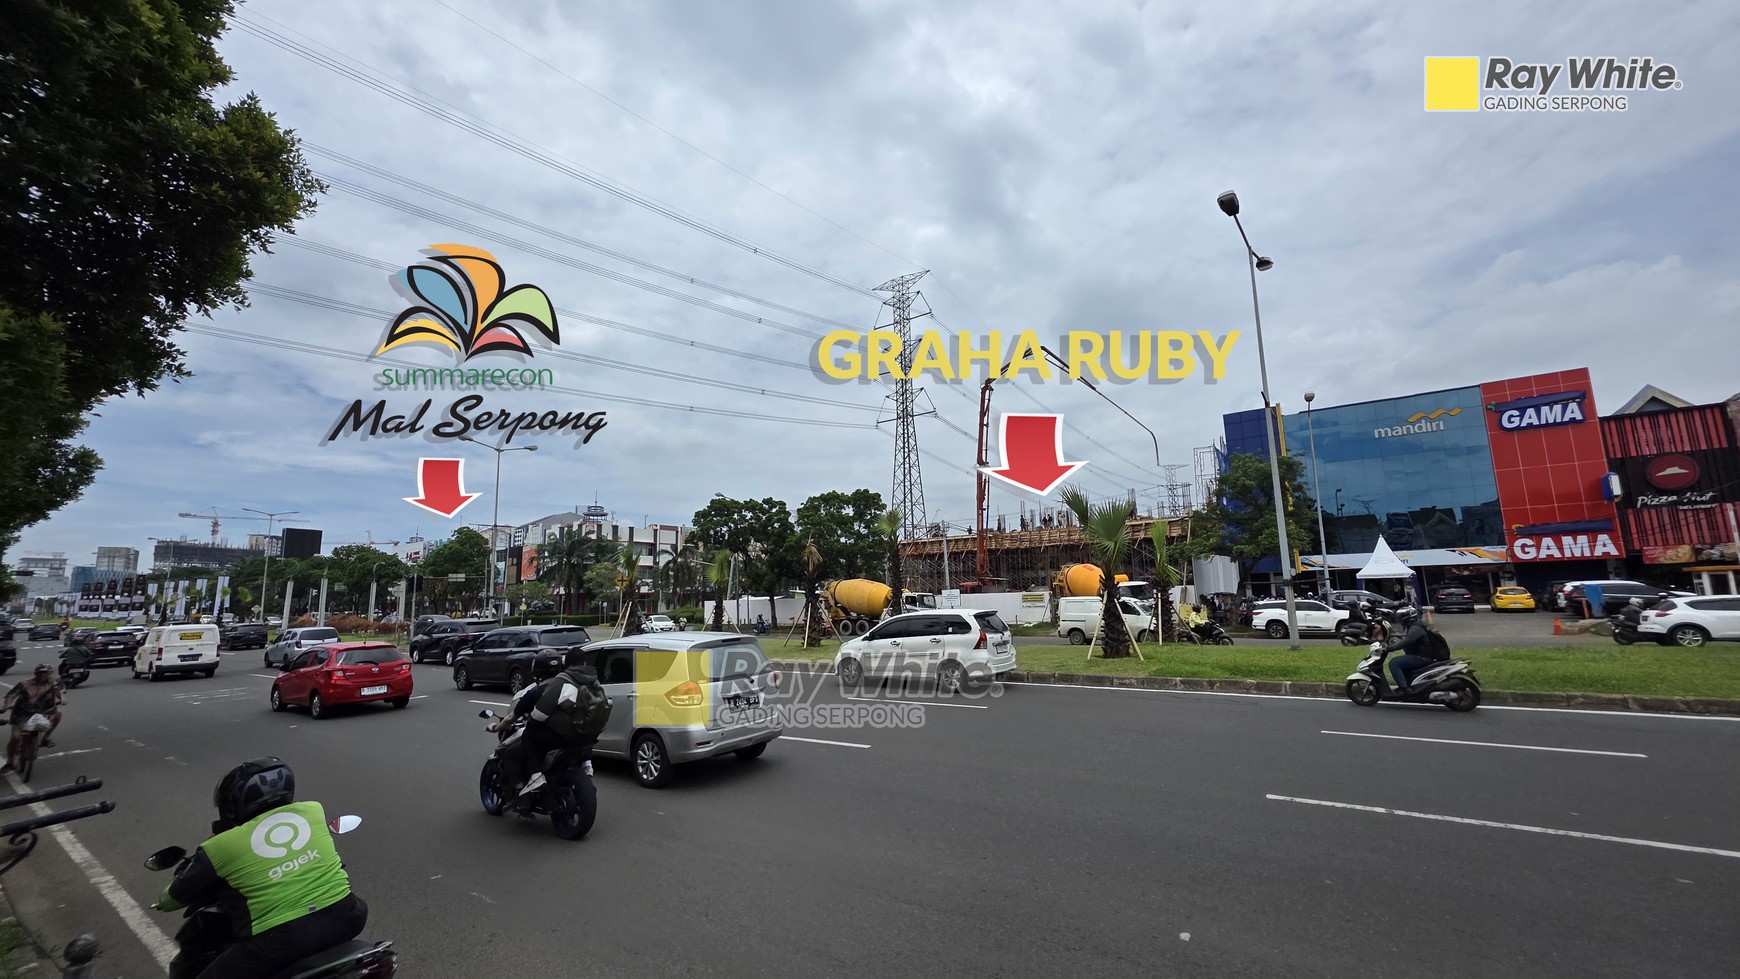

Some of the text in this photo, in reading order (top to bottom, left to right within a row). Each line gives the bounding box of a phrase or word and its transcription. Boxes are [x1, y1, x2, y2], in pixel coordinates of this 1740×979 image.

[1501, 402, 1583, 428] GAMA
[1374, 419, 1445, 439] mandiri
[1636, 494, 1678, 508] Pizza
[1513, 533, 1619, 560] GAMA
[268, 849, 320, 880] gojek
